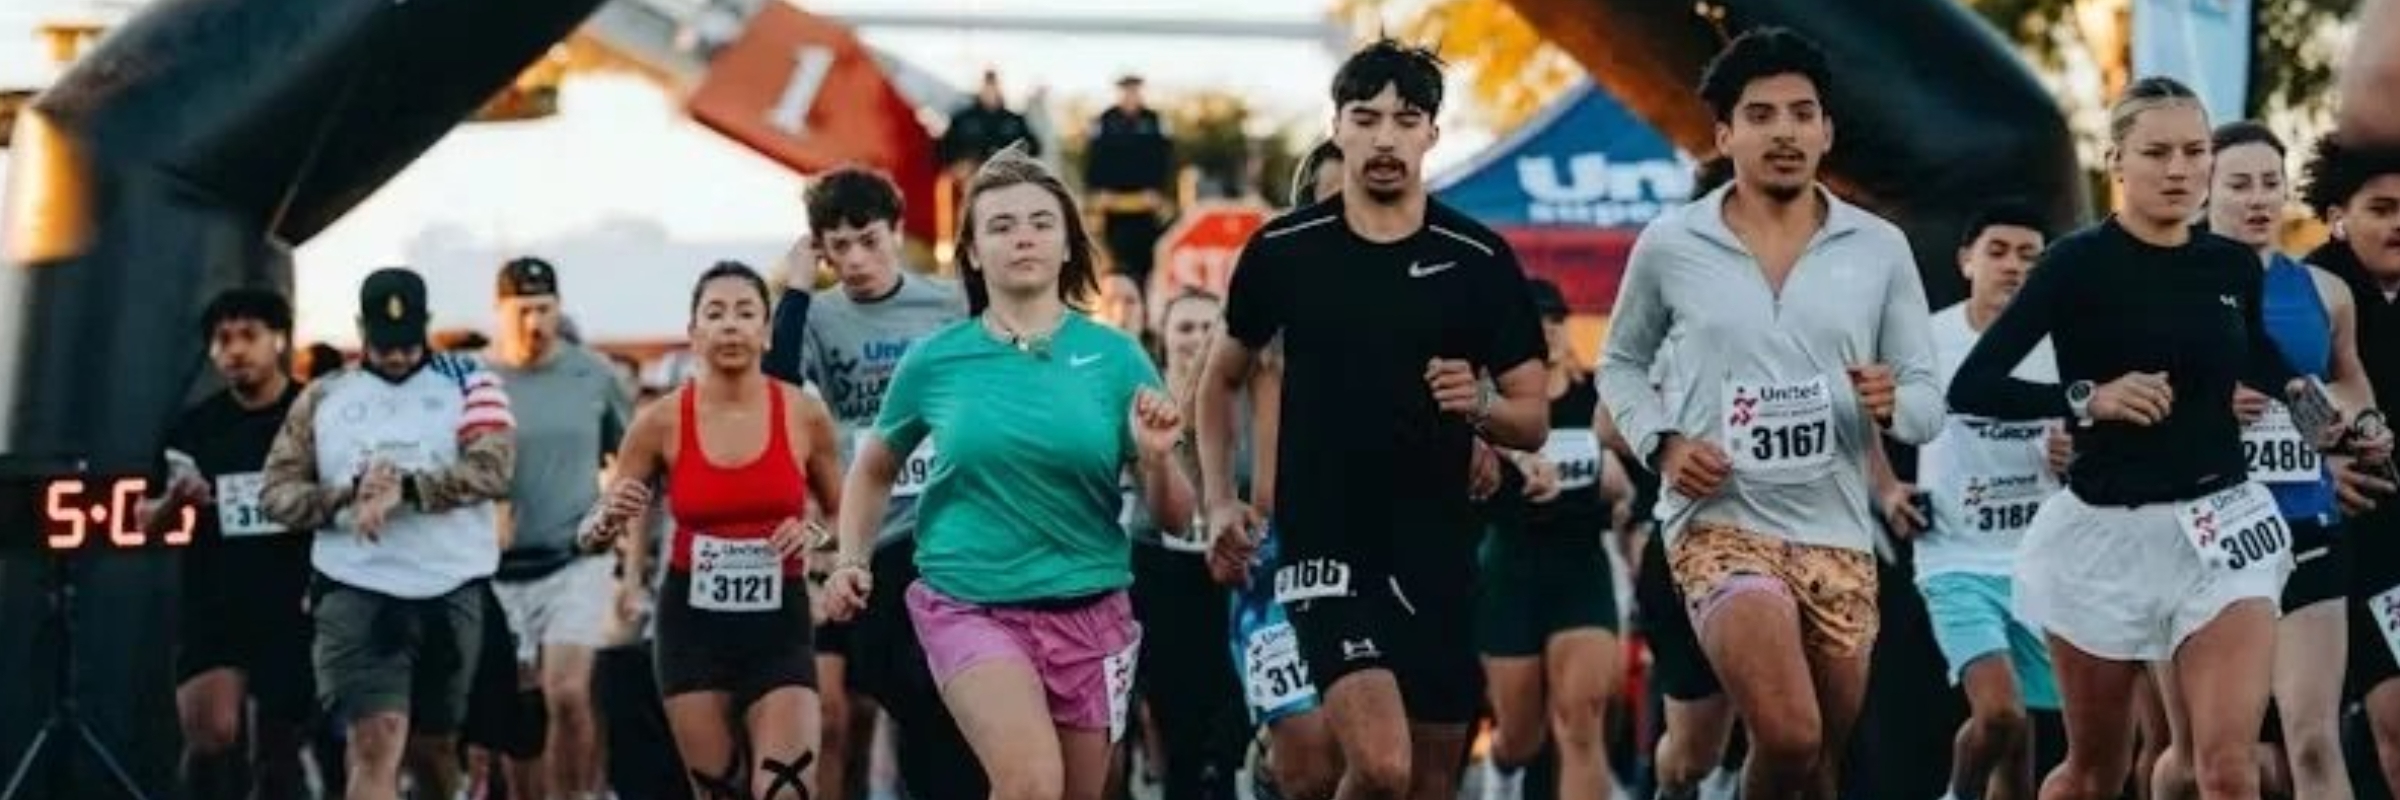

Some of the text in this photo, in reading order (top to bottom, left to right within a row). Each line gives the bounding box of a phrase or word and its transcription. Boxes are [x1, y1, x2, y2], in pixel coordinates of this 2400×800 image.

[1760, 381, 1820, 402] United
[1751, 419, 1826, 460] 3167
[2242, 440, 2316, 472] 2486
[2219, 515, 2286, 570] 3007
[712, 574, 774, 603] 3121
